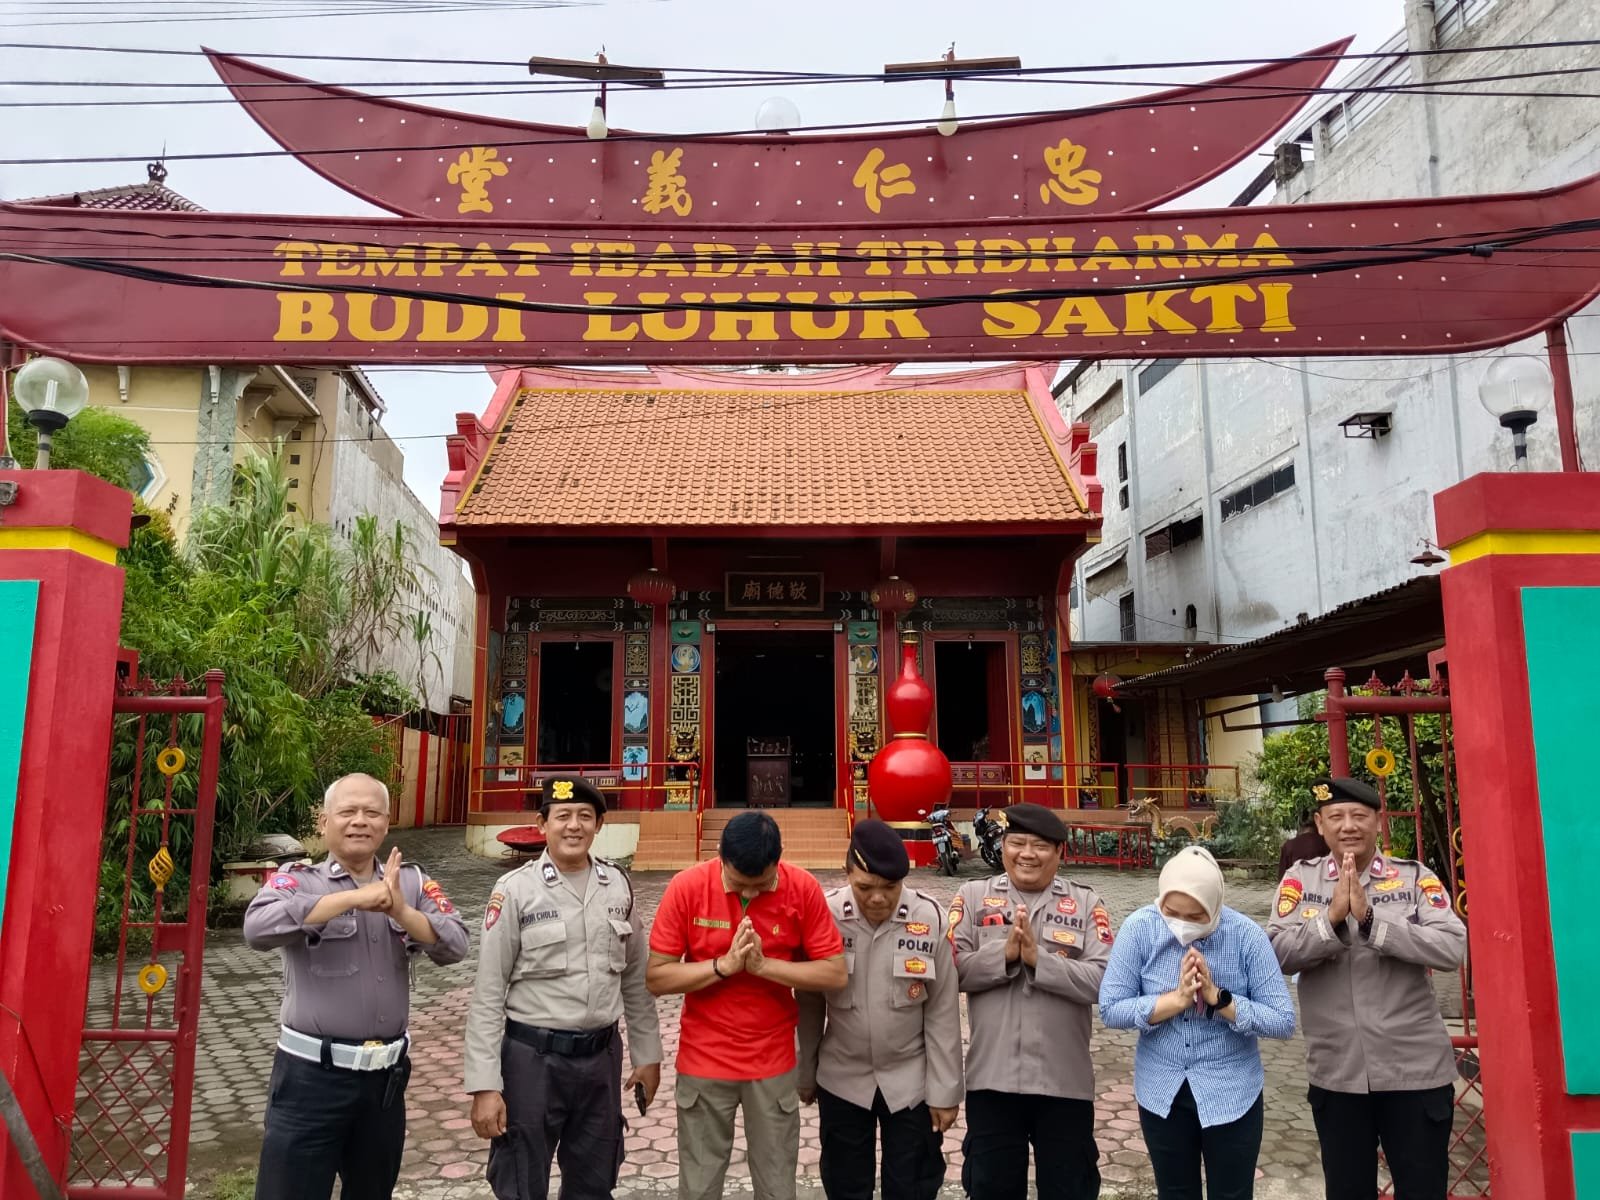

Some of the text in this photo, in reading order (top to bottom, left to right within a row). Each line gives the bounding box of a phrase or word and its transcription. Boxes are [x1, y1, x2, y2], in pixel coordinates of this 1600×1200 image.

[273, 232, 1294, 277] TEMPAT IBADAH TRIDHARMA
[273, 282, 1297, 342] BUDI LUHUR SAKTI
[1372, 891, 1411, 906] POLRI
[608, 907, 628, 915] POL
[1046, 912, 1083, 929] POLRI
[898, 938, 934, 954] POLRI
